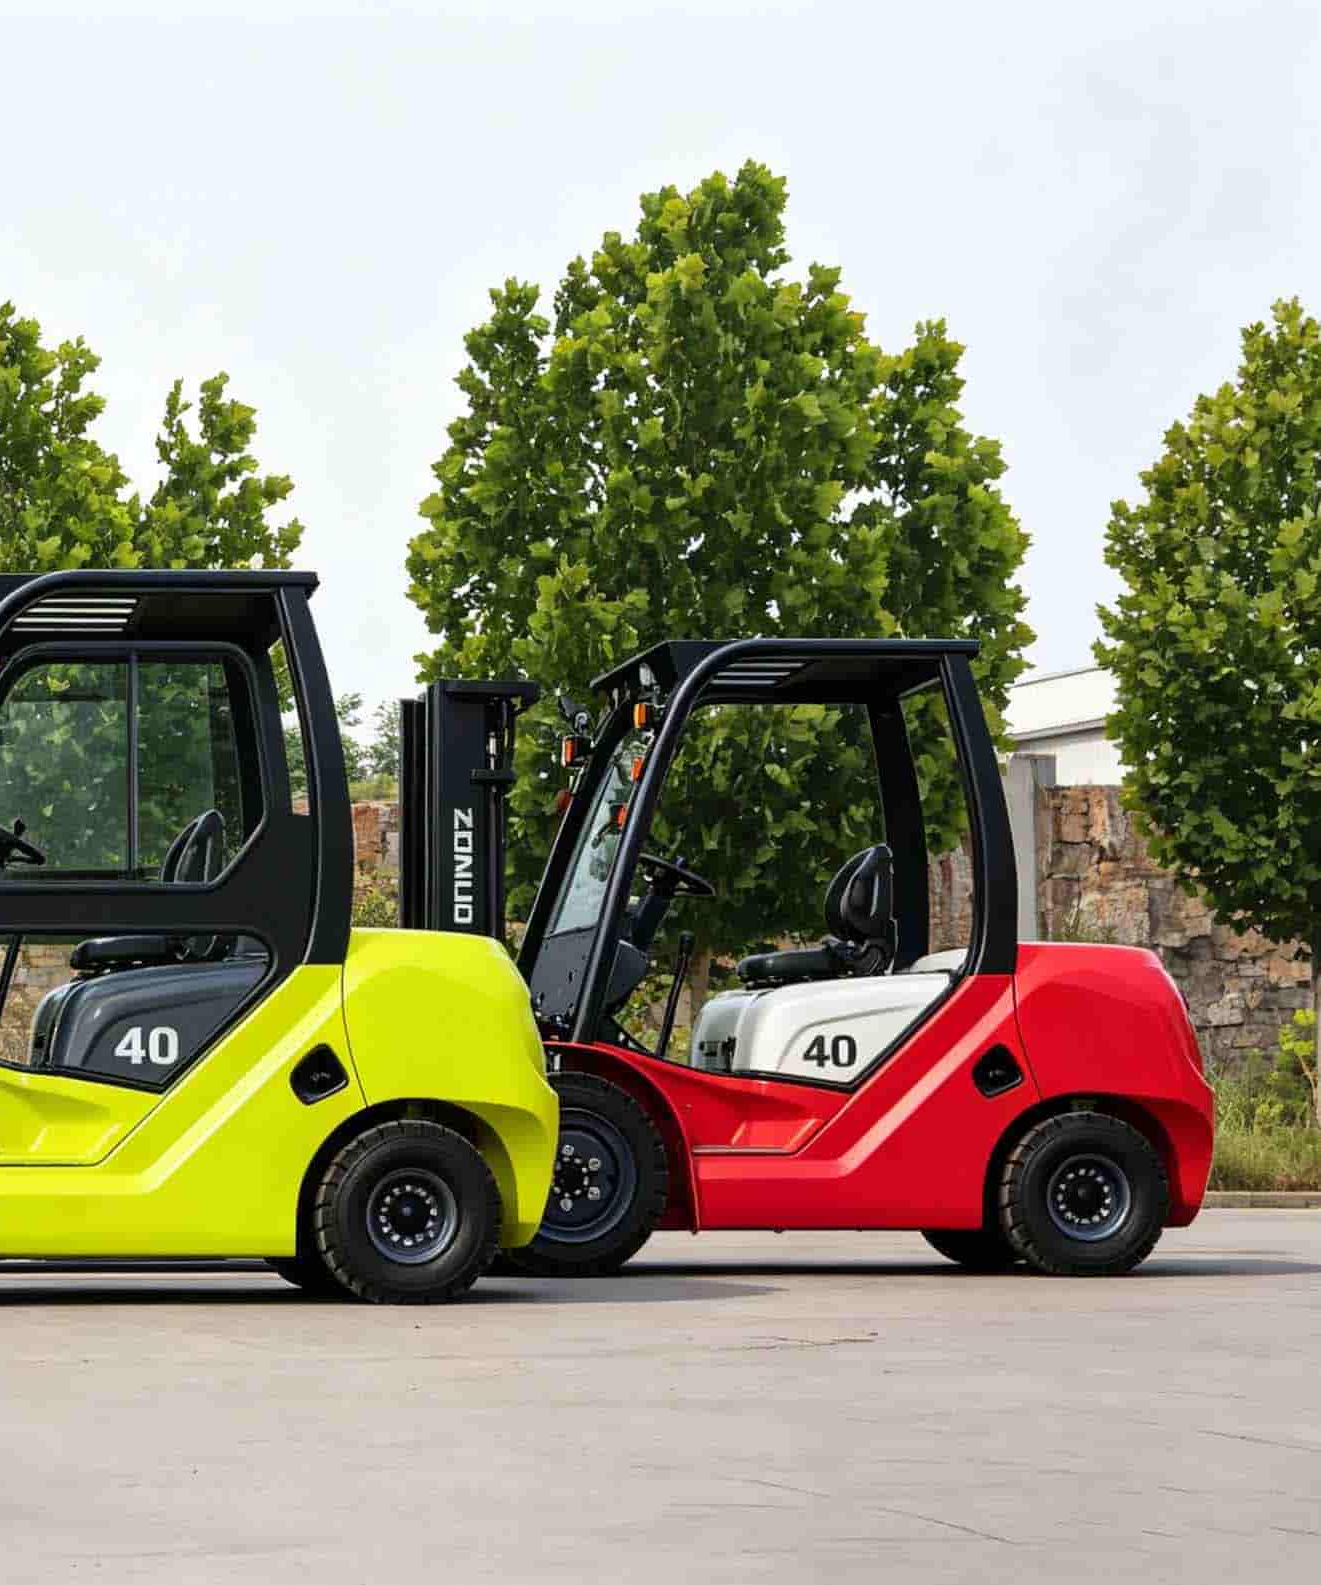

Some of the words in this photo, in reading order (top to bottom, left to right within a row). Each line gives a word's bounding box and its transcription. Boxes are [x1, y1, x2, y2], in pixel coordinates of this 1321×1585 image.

[453, 807, 474, 924] ZONUO
[114, 1026, 178, 1065] 40
[803, 1035, 857, 1068] 40
